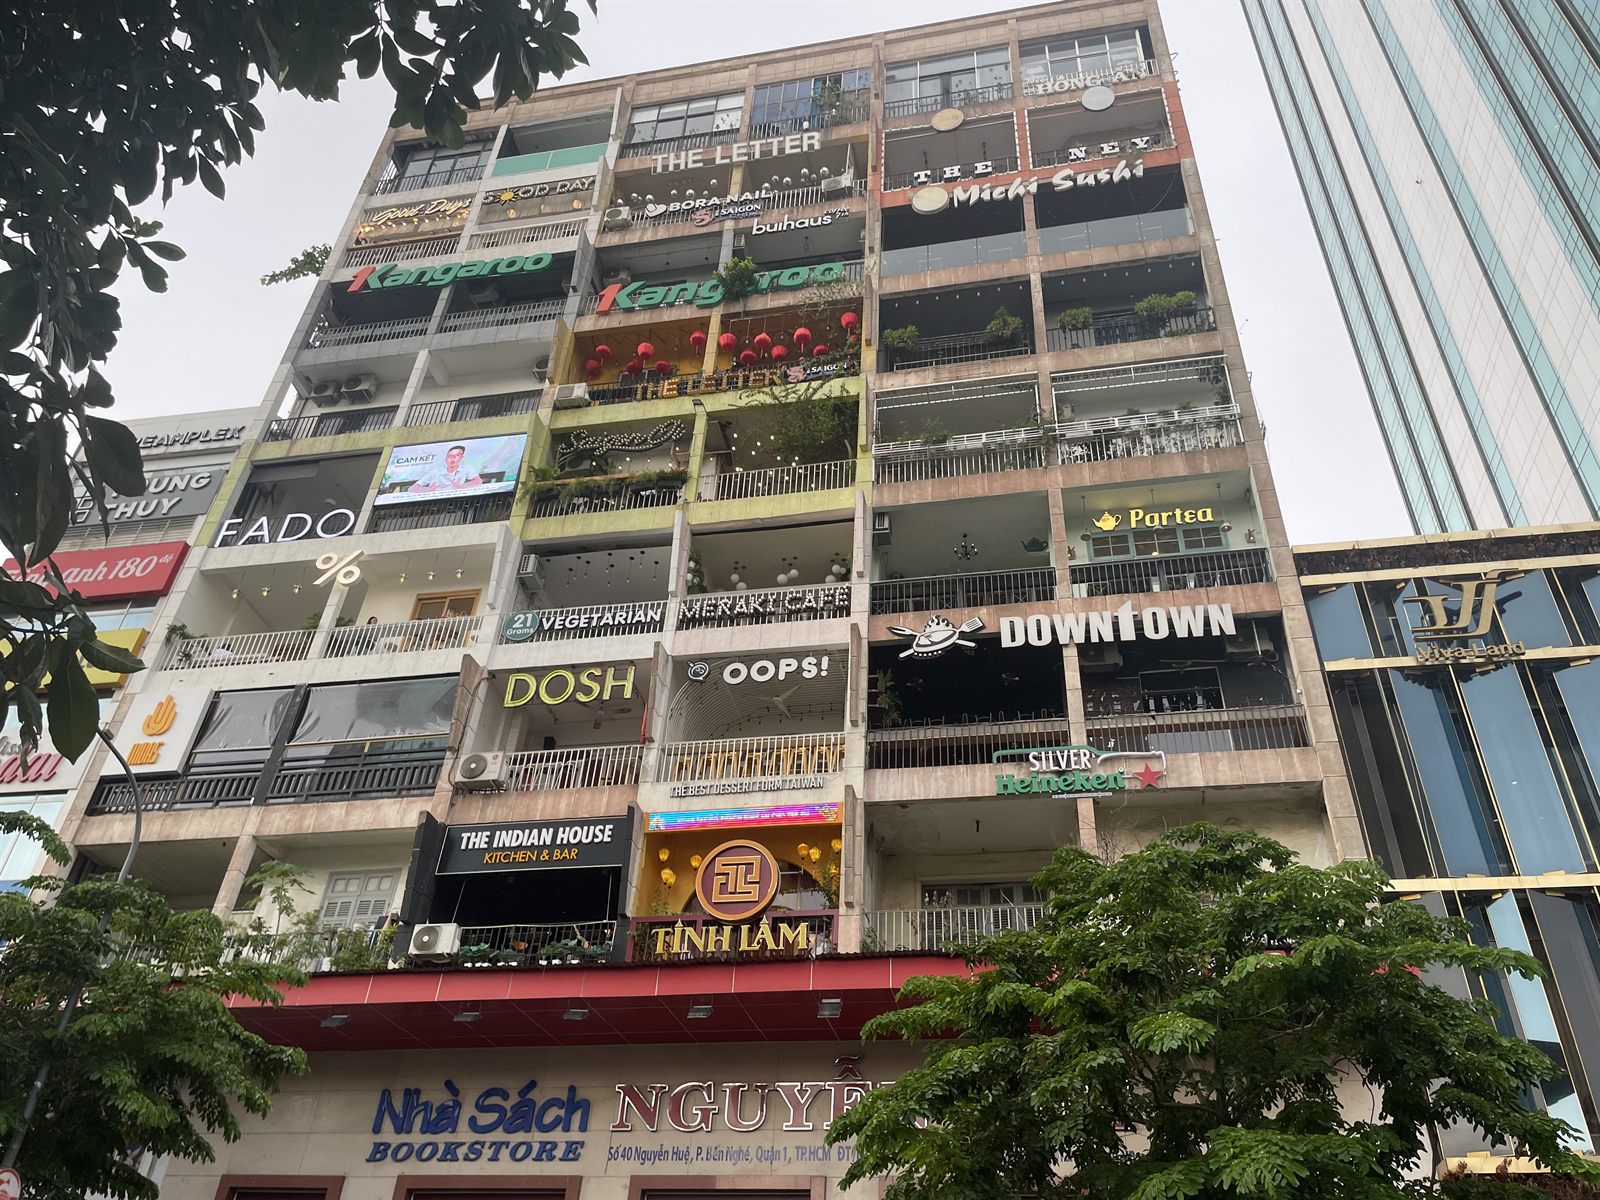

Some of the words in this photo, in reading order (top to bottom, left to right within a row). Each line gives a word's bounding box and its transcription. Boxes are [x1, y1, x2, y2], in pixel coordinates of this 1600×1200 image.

[651, 149, 704, 175] THE
[715, 132, 822, 165] LETTER
[914, 160, 992, 183] THE
[953, 176, 1038, 208] Michi
[1051, 159, 1144, 192] Sushi
[372, 204, 425, 226] Good
[425, 198, 472, 215] Days
[668, 196, 721, 213] BORA
[726, 188, 773, 204] NAIL
[752, 214, 832, 236] buihaus
[596, 262, 845, 315] Kangroo
[636, 378, 679, 401] THE
[136, 426, 246, 449] EAMPLEX
[214, 508, 355, 548] FADO
[1129, 506, 1214, 528] Partea
[108, 555, 158, 580] 180
[679, 594, 776, 619] MERAKI
[506, 627, 535, 637] Grams
[512, 614, 533, 628] 21
[541, 608, 662, 632] VEGETARIAN
[1416, 644, 1472, 663] Viva
[1473, 641, 1527, 658] Land
[722, 656, 830, 685] OOPS!
[503, 665, 637, 708] DOSH
[1029, 749, 1092, 771] SILVER
[670, 785, 687, 798] THE
[689, 782, 711, 797] BEST
[715, 780, 755, 795] DESSERT
[757, 778, 783, 793] FORM
[785, 776, 824, 790] TAIWAN
[995, 770, 1125, 795] Heineken
[460, 831, 491, 850] THE
[493, 827, 554, 849] INDIAN
[556, 824, 614, 845] HOUSE
[483, 850, 537, 864] KITCHEN
[540, 850, 550, 861] &
[553, 848, 578, 861] BAR
[739, 914, 809, 951] LÂM
[610, 1055, 897, 1132] NGUYỄ
[372, 1079, 462, 1134] Nhà
[468, 1079, 591, 1133] Sách
[366, 1140, 585, 1162] BOOKSTORE
[607, 1144, 620, 1161] Số
[621, 1147, 632, 1161] 40
[634, 1144, 669, 1166] Nguyễn
[696, 1147, 704, 1161] P.
[756, 1146, 780, 1164] Quận
[795, 1146, 831, 1161] TP.HCM
